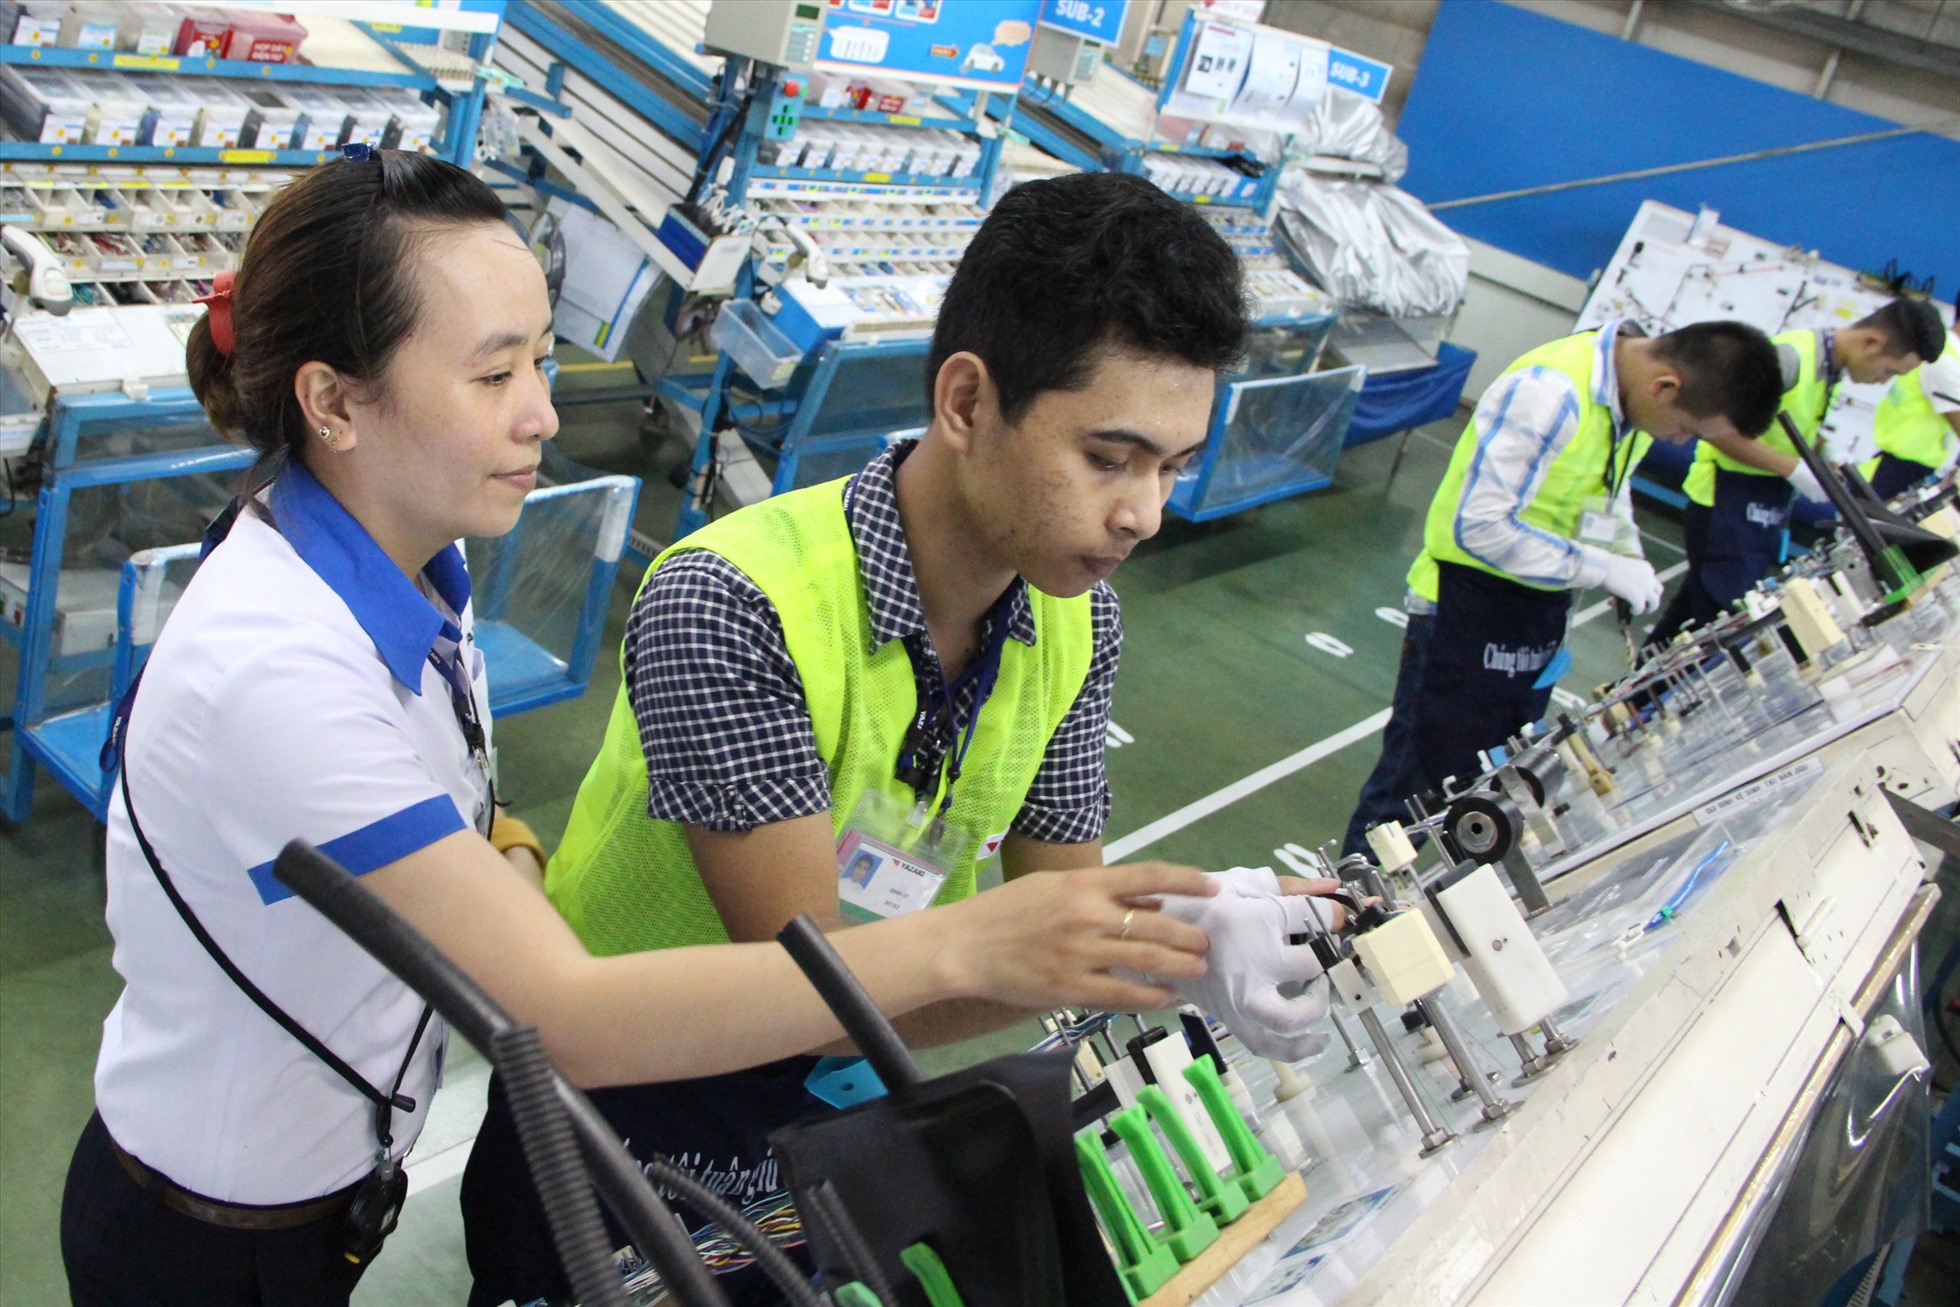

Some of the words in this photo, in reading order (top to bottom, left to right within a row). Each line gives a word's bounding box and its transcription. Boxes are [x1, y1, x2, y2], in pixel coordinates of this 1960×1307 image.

[1056, 0, 1105, 28] SUB-2
[1330, 61, 1371, 88] SUB-3
[901, 862, 926, 877] YAZAKI
